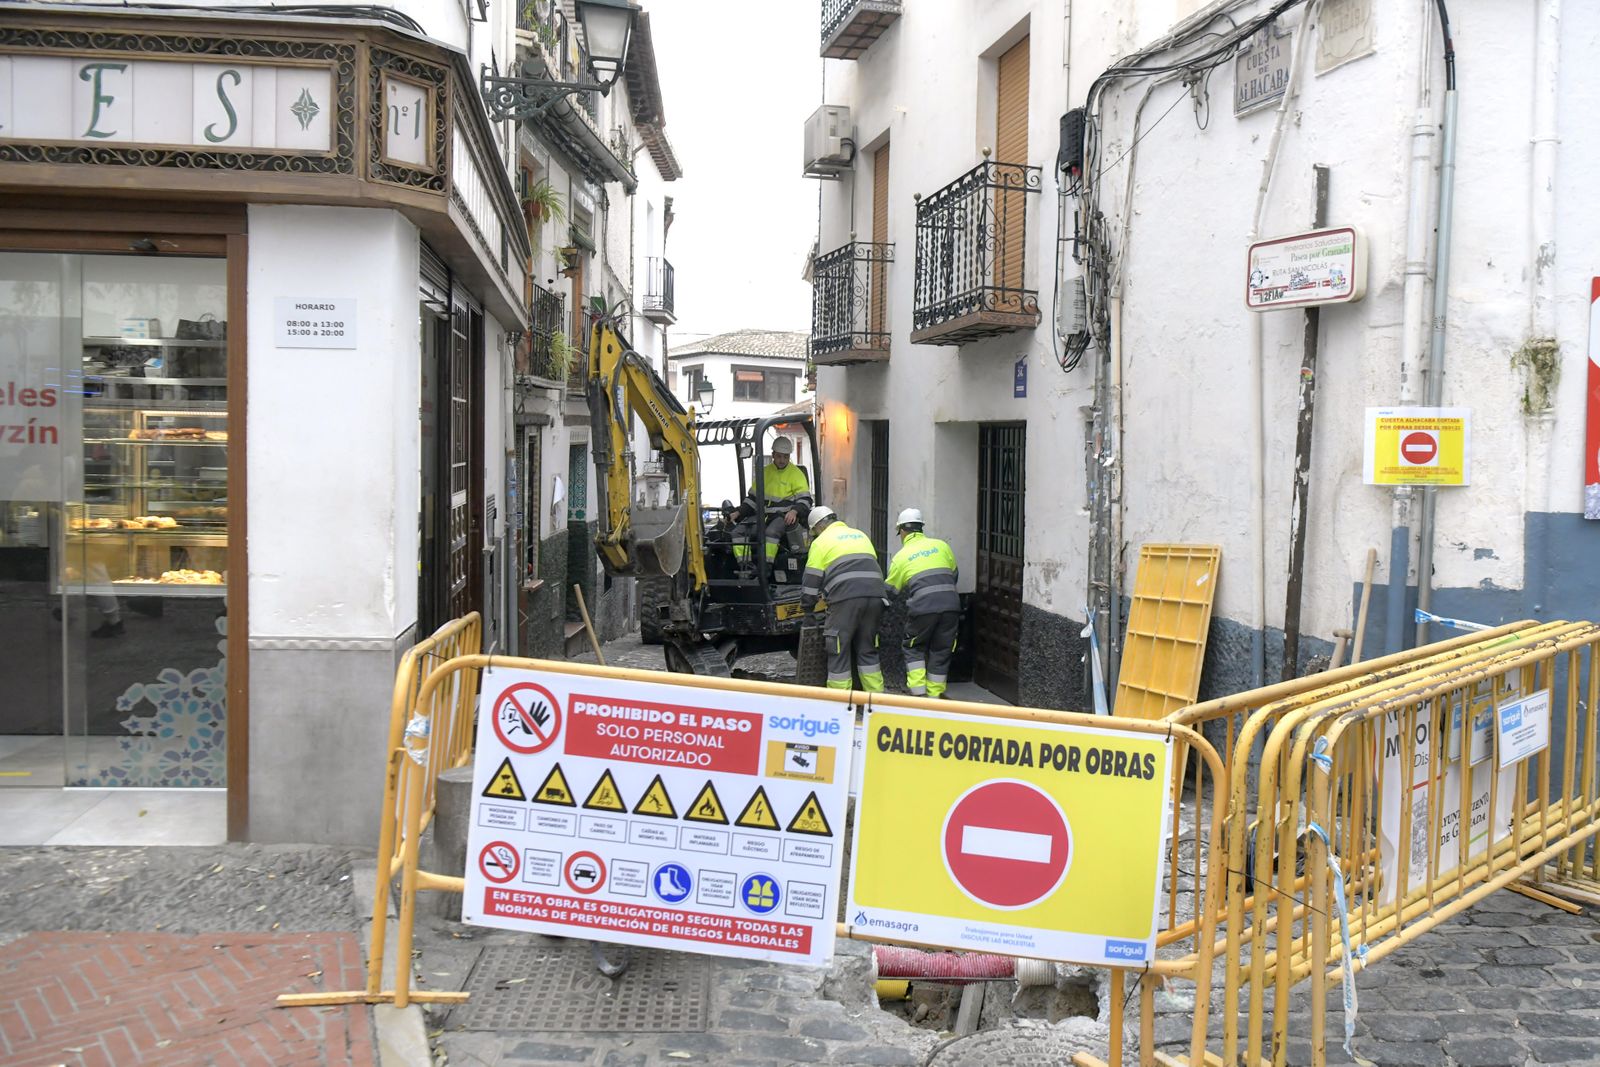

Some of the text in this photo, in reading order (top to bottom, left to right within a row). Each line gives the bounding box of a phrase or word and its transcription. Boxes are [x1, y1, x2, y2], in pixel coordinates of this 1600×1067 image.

[1246, 45, 1281, 71] CUESTA
[1258, 65, 1270, 75] DE
[1309, 251, 1320, 261] por
[1322, 244, 1351, 257] Granada
[295, 303, 335, 311] HORARIO
[320, 329, 344, 337] 20:00
[0, 381, 57, 408] les
[573, 701, 753, 733] PROHIBIDO EL PASO
[596, 722, 725, 750] SOLO PERSONAL
[610, 743, 712, 766] AUTORIZADO
[876, 725, 1156, 781] CALLE CORTADA POR OBRAS
[493, 890, 804, 938] EN ESTA OBRA ES OBLIGATORIO SEGUIR TODAS LAS
[495, 902, 800, 949] NORMAS DE PREVENCIÓN DE RIESGOS LABORALES
[869, 918, 919, 933] emasagra
